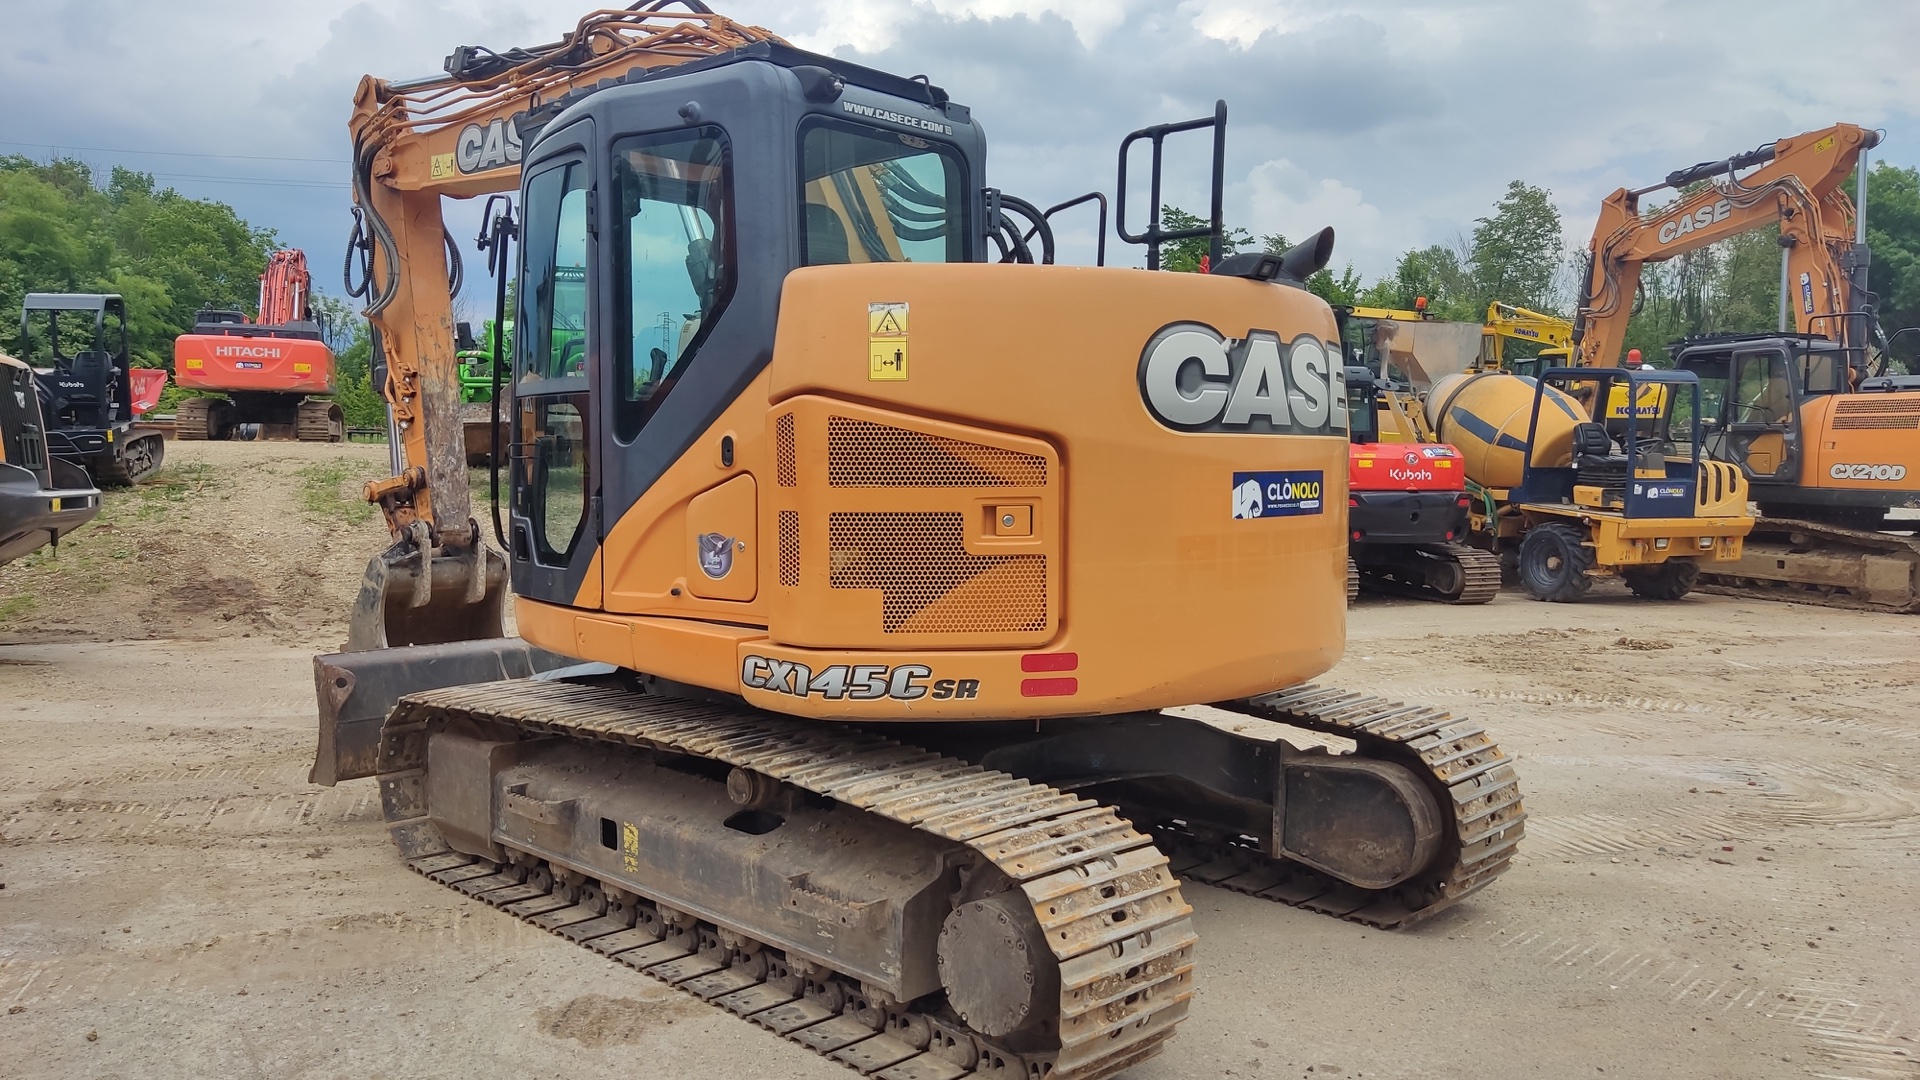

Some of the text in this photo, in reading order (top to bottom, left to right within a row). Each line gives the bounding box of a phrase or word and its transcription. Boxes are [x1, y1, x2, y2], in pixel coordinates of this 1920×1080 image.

[843, 101, 943, 133] WWW.CASECE.COM
[1658, 199, 1731, 244] CASE
[1513, 327, 1539, 338] KOMATSU
[216, 346, 281, 358] HITACHI
[1143, 327, 1347, 430] CASE
[1389, 468, 1432, 480] Kubota
[1830, 463, 1907, 481] CX210D
[1267, 477, 1320, 501] CLÒNOLO
[742, 655, 980, 701] CX145C SR
